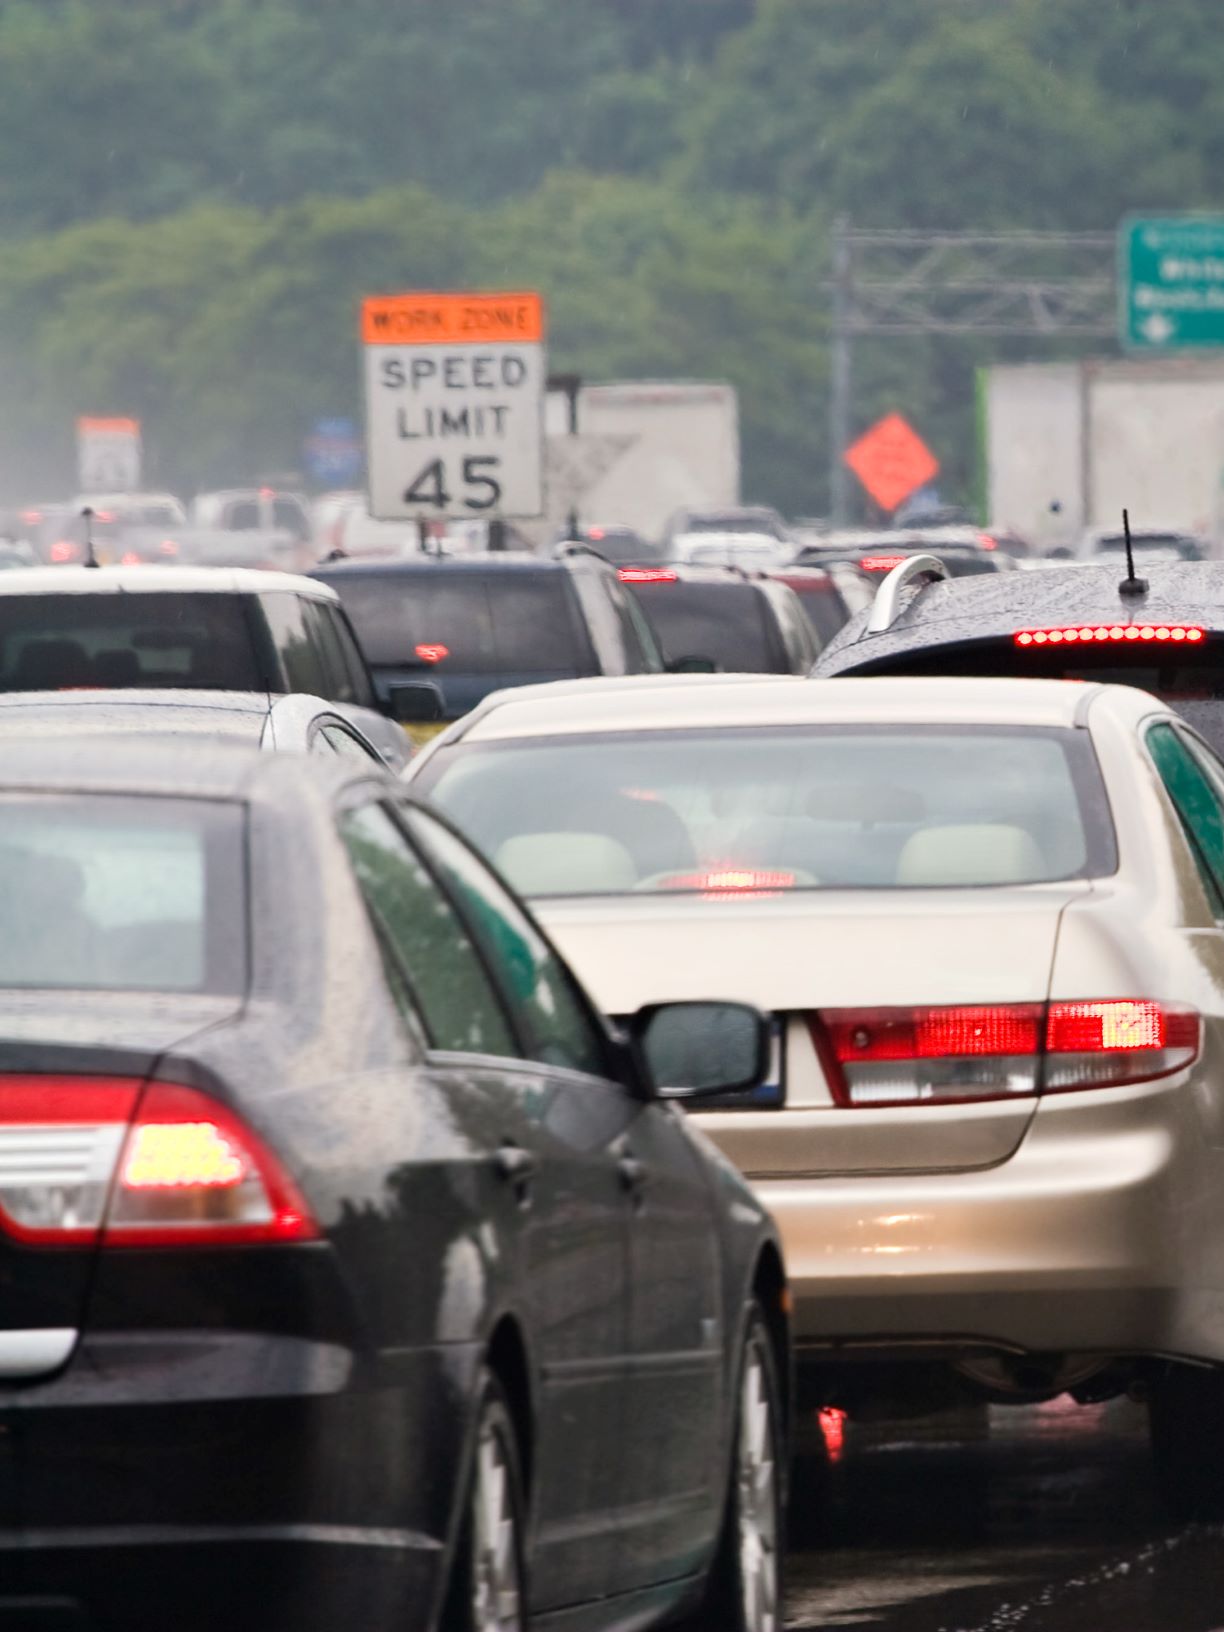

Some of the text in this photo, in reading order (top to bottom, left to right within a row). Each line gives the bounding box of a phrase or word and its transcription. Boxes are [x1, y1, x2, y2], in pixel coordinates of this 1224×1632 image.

[371, 306, 528, 333] WORK ZONE
[380, 354, 527, 392] SPEED
[396, 405, 510, 440] LIMIT
[402, 454, 503, 511] 45
